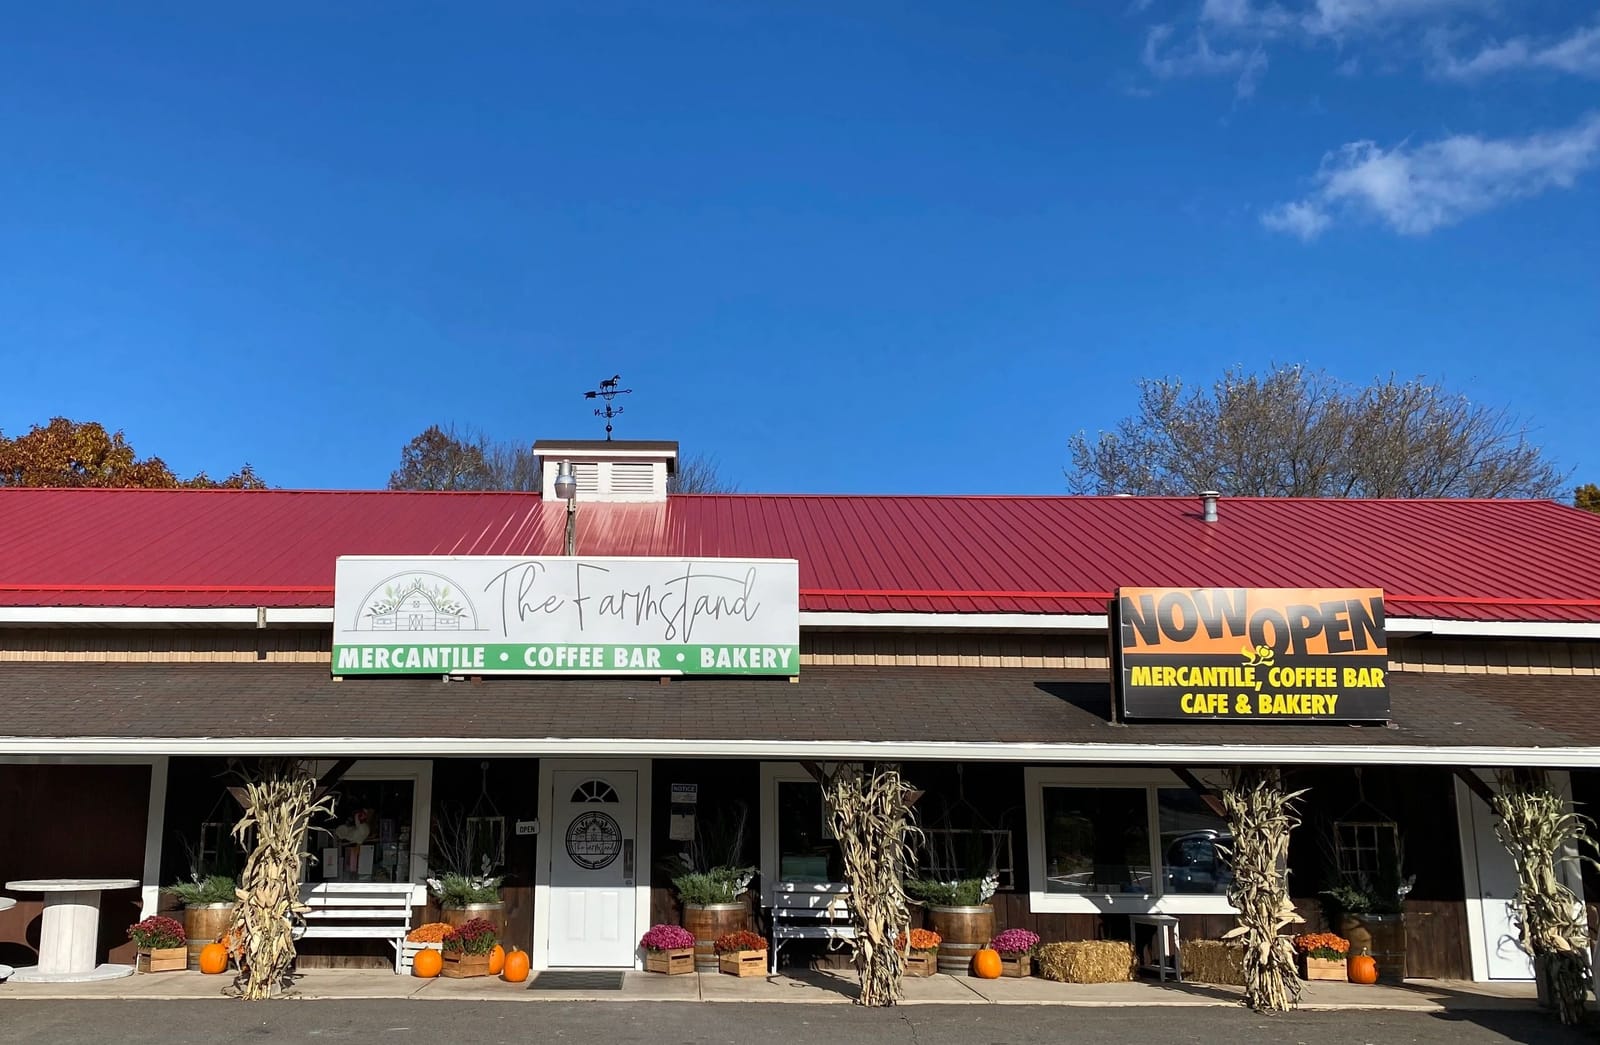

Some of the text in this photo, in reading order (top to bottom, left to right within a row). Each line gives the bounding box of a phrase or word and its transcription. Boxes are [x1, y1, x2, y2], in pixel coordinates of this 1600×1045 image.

[484, 561, 760, 643] The Farmstand
[1122, 589, 1387, 656] NOW OPEN
[338, 647, 791, 669] MERCANTILE COFFEE BAR BAKERY
[1130, 666, 1385, 691] MERCANTILE, COFFEE BAR
[1181, 693, 1338, 715] CAFE & BAKERY
[519, 825, 536, 834] OPEN
